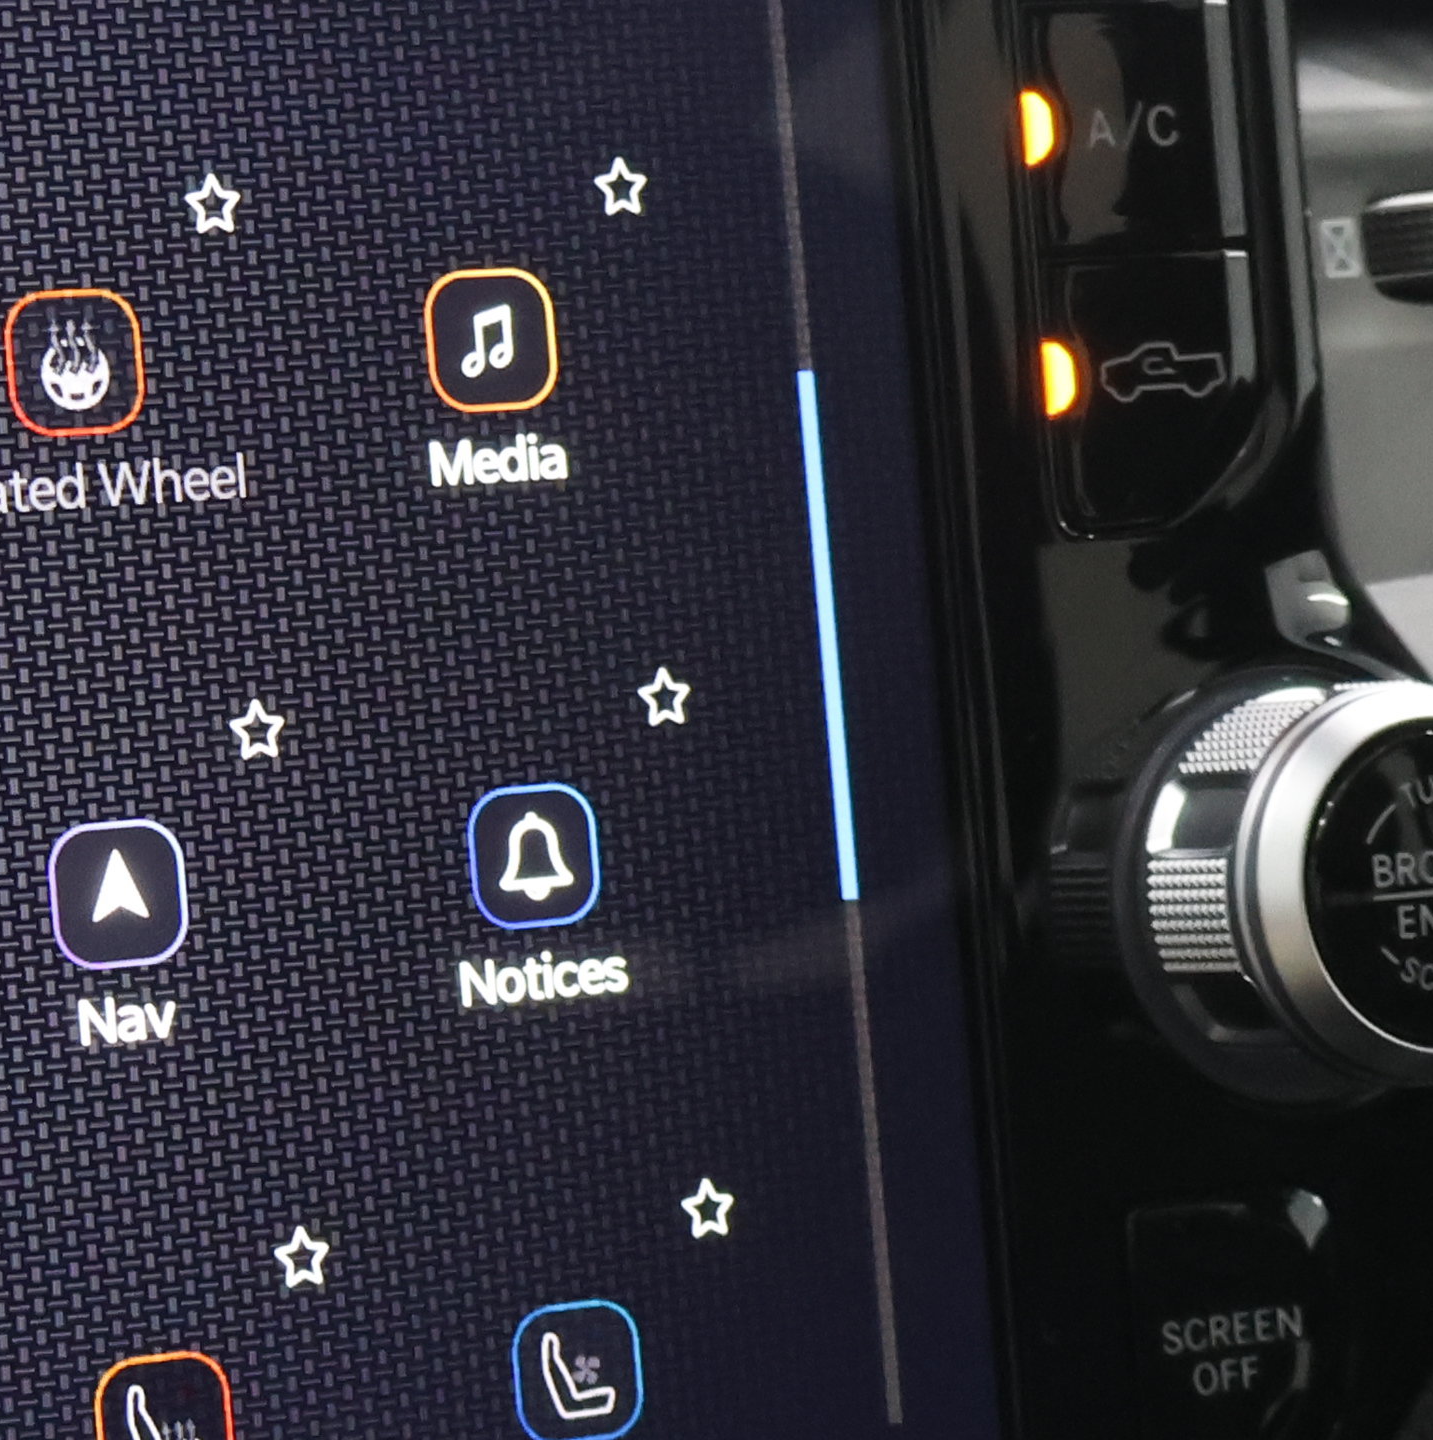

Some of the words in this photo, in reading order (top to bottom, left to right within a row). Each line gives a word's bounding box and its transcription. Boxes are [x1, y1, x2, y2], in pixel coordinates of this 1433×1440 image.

[1089, 104, 1179, 148] A/C
[99, 453, 248, 506] Wheel
[429, 432, 568, 486] Media
[459, 948, 629, 1009] Notices
[78, 997, 178, 1047] Nav
[1163, 1306, 1303, 1354] SCREEN
[1193, 1358, 1260, 1398] OFF
